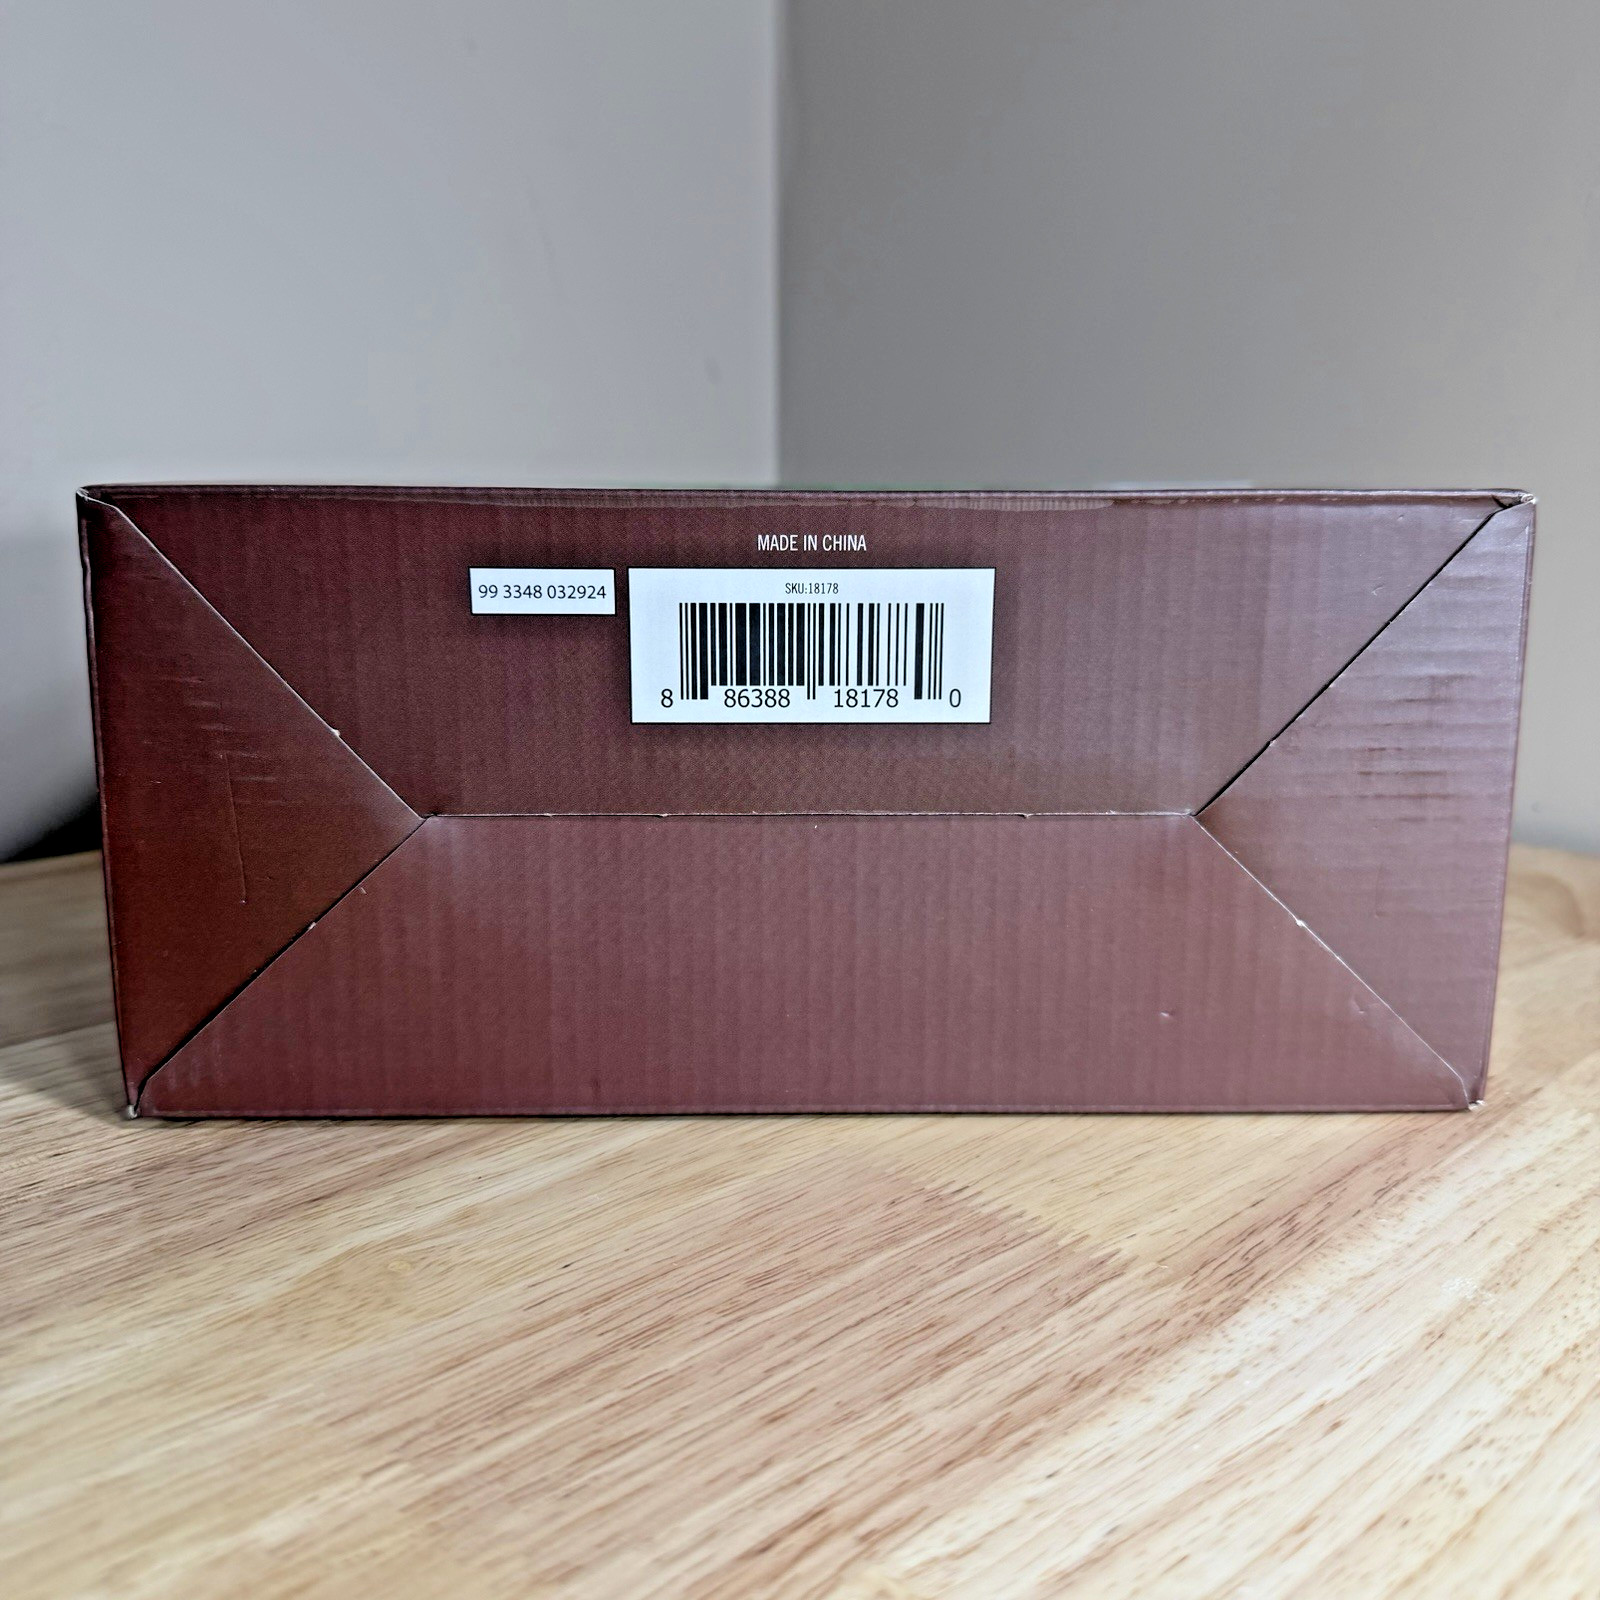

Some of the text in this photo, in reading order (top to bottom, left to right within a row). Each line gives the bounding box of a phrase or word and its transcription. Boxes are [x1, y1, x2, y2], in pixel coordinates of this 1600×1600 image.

[757, 534, 867, 552] MADE IN CHINA
[478, 584, 607, 600] 99 3348 032924
[784, 582, 839, 595] SKU:18178
[660, 688, 962, 709] 8 86388 18178 0
